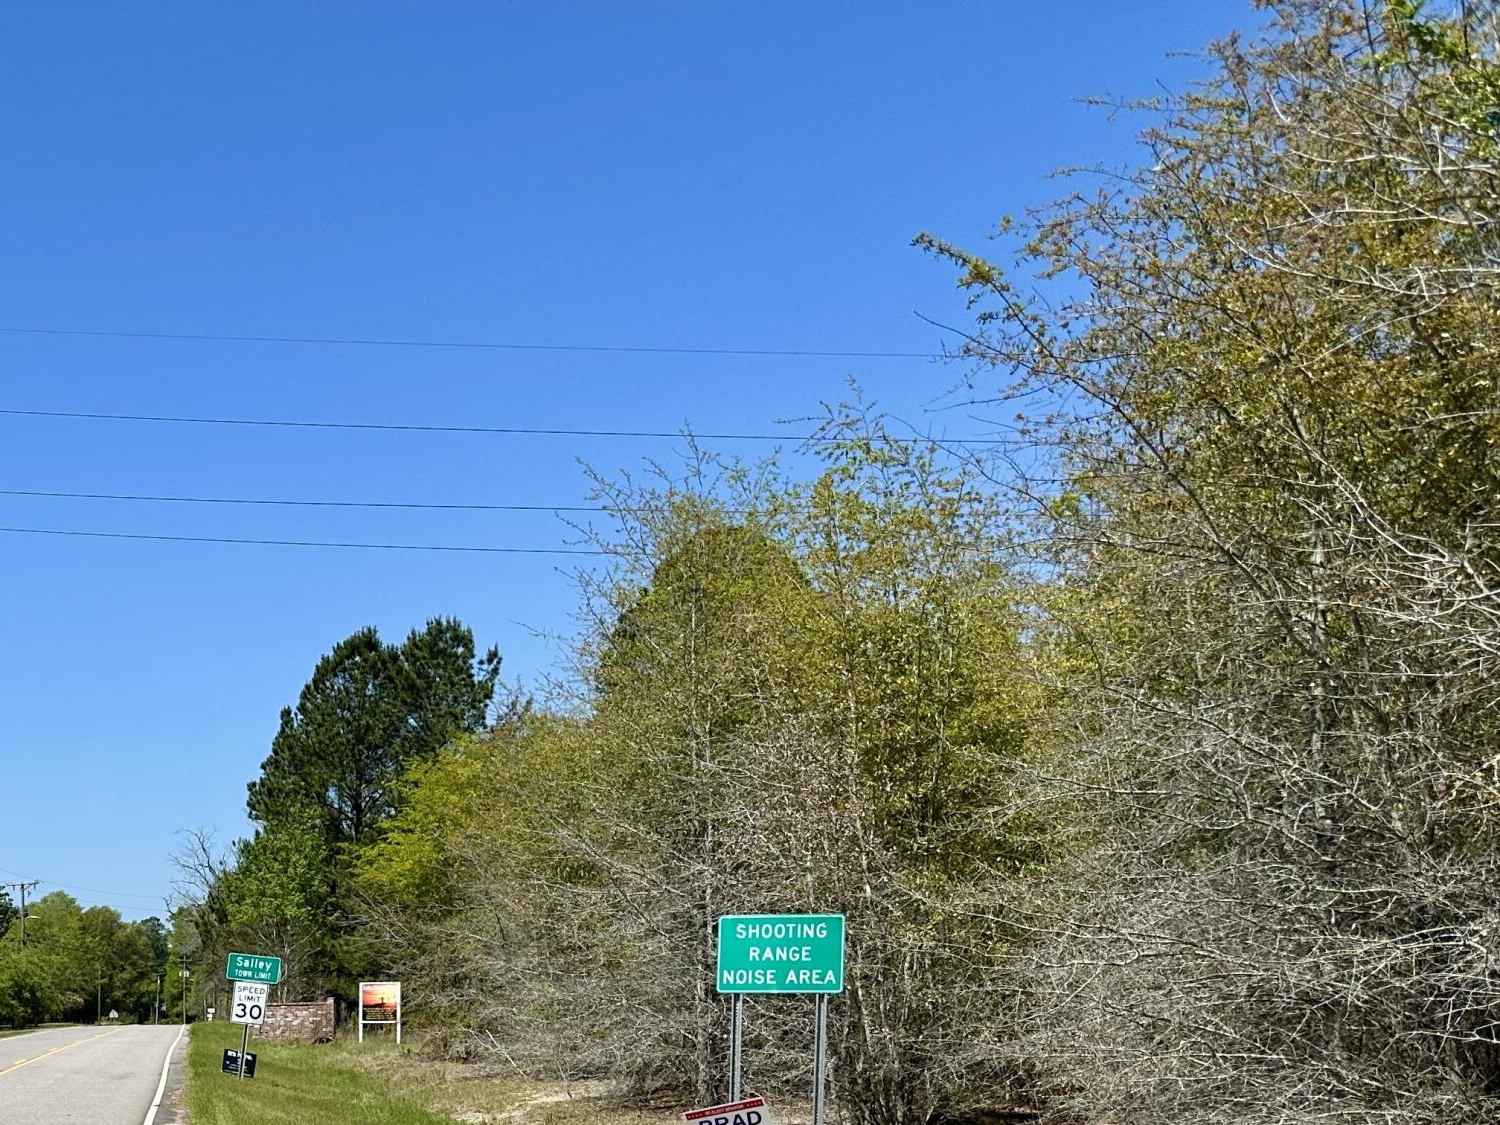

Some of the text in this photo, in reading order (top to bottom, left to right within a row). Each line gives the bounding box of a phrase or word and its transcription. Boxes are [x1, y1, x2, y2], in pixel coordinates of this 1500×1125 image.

[736, 924, 827, 939] SHOOTING
[749, 946, 812, 961] RANGE
[236, 956, 272, 972] Salley
[235, 969, 271, 980] TOWN LIMIT
[723, 969, 836, 984] NOISE AREA
[237, 985, 265, 995] SPEED
[239, 995, 261, 1003] LIMIT
[235, 1003, 262, 1020] 30
